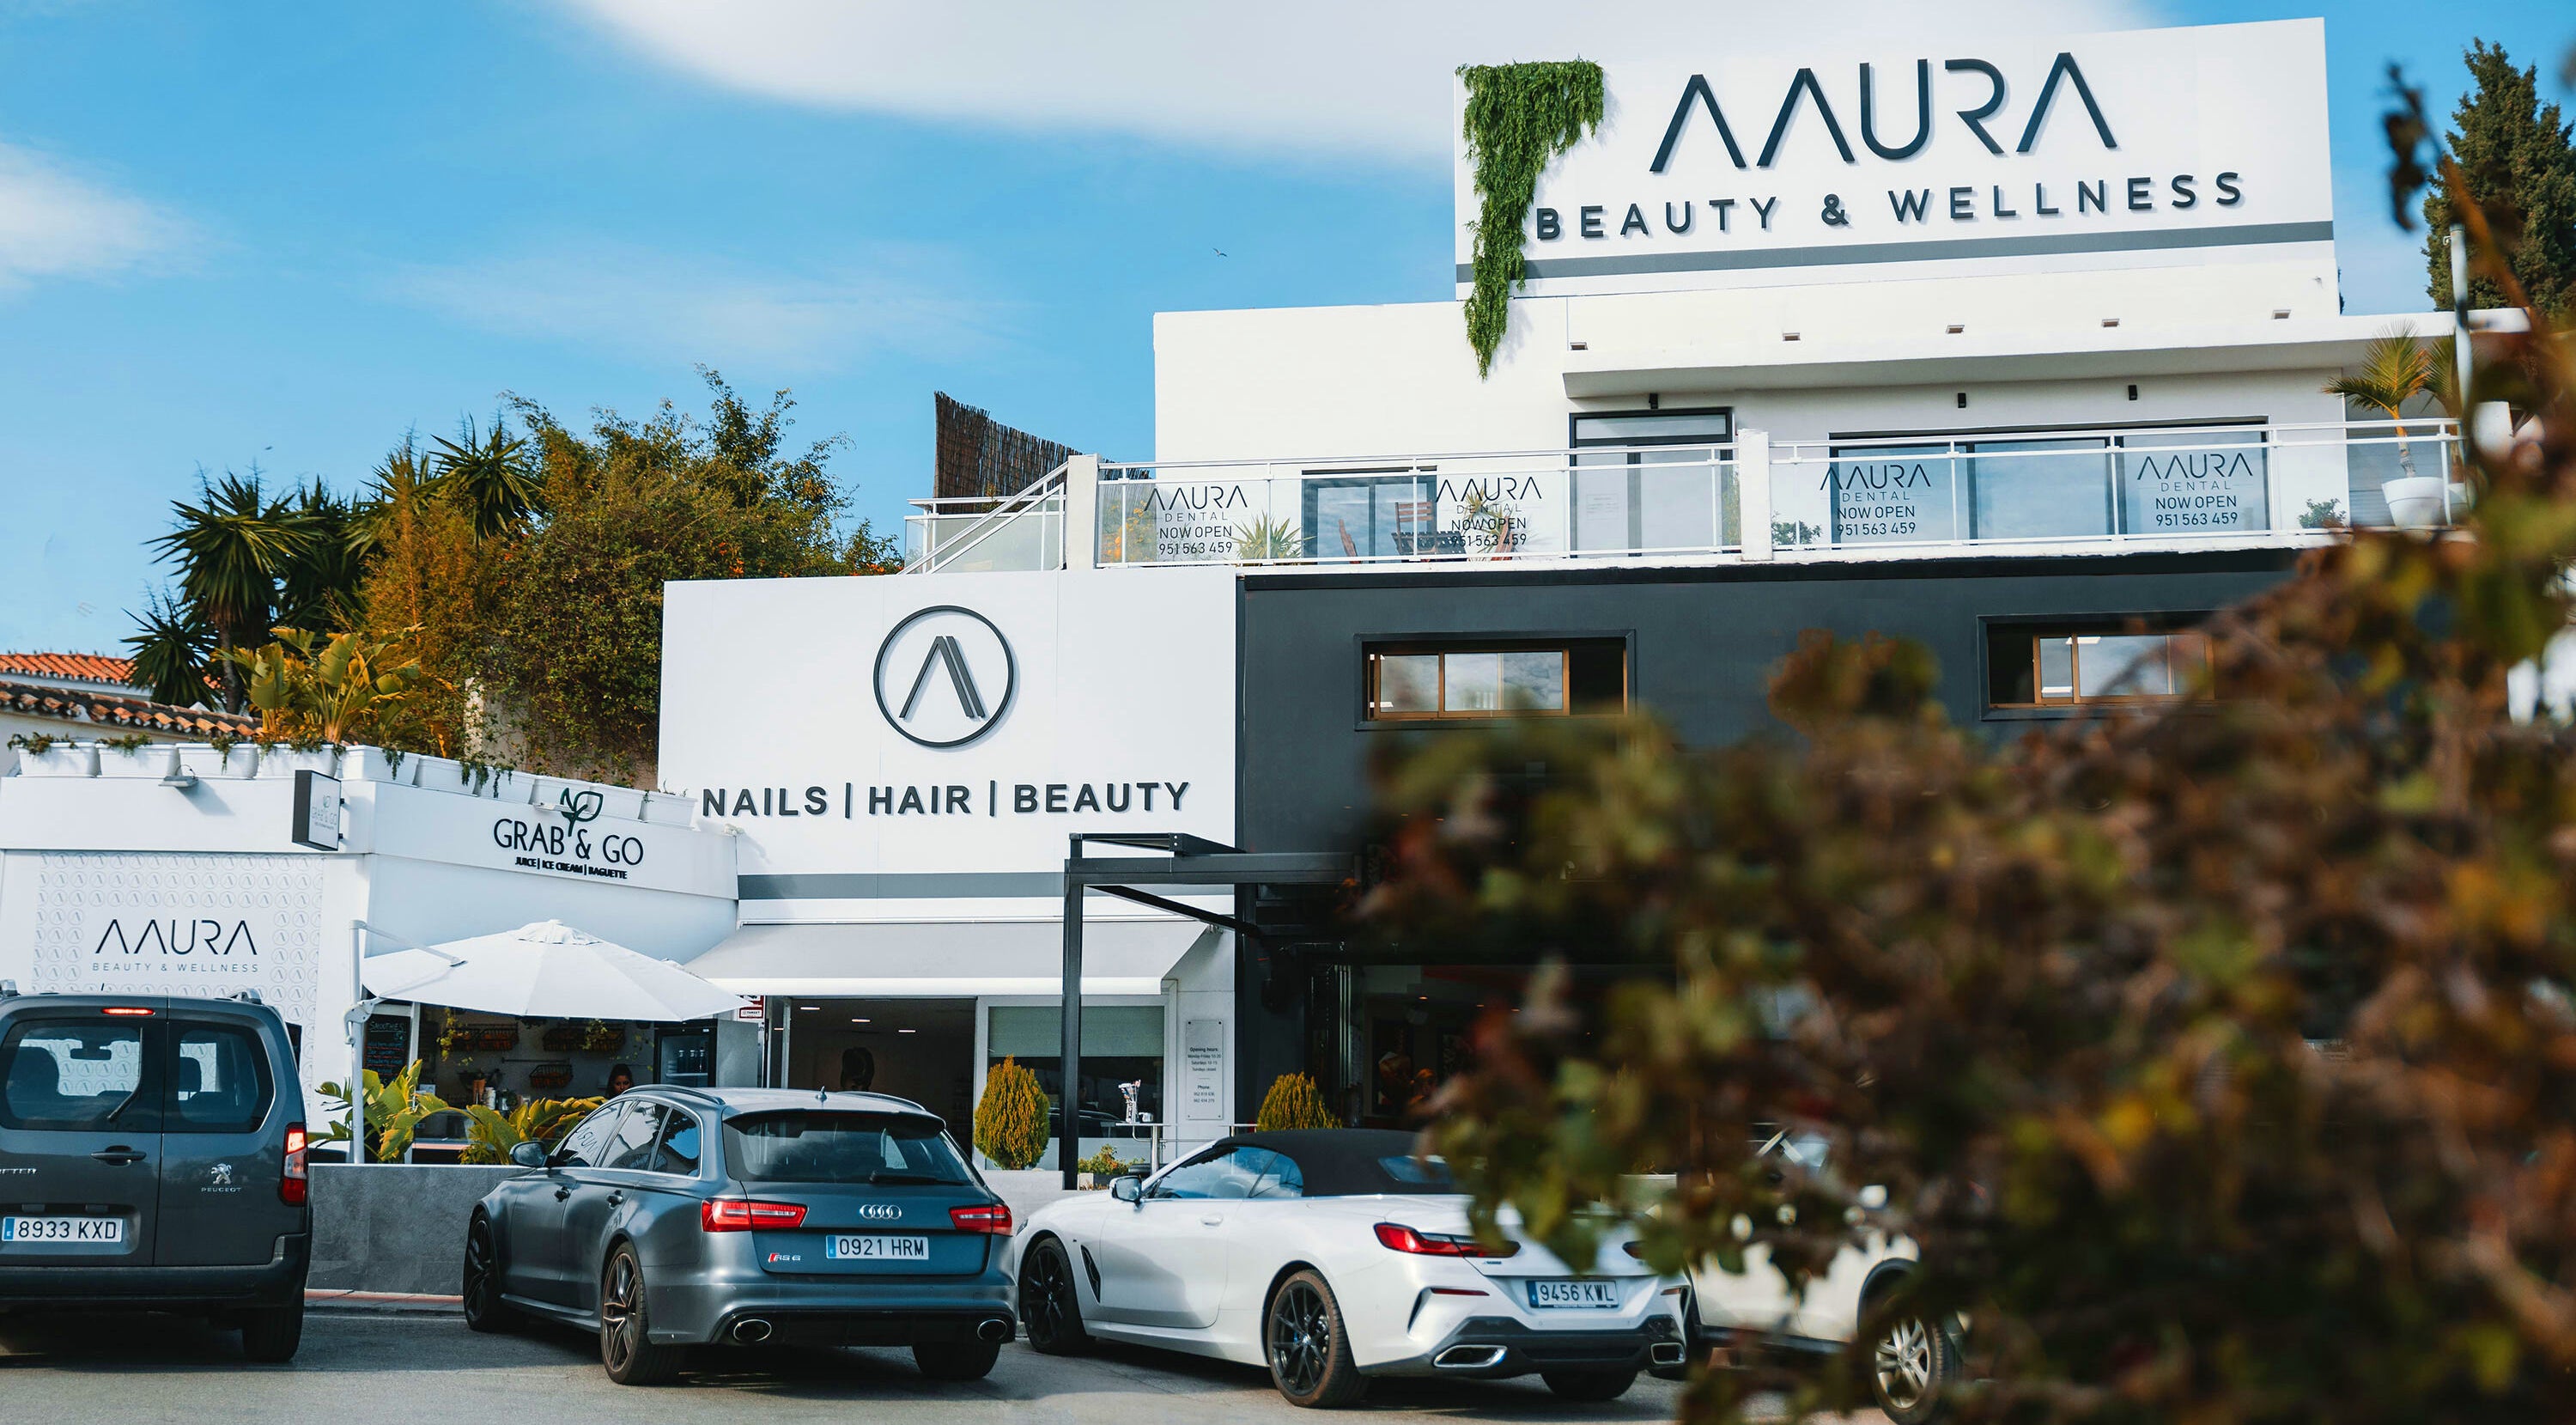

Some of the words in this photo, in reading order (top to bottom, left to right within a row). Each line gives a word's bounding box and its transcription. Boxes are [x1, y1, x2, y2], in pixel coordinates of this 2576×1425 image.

[1649, 52, 2117, 174] AAURA
[1535, 196, 1777, 241] BEAUTY
[1820, 193, 1850, 226] &
[1887, 172, 2242, 223] WELLNESS
[2136, 452, 2254, 480] AAURA
[1820, 463, 1931, 490] AAURA
[2160, 480, 2232, 492] DENTAL
[1144, 484, 1248, 512] AAURA
[1842, 490, 1911, 502] DENTAL
[2155, 496, 2191, 510] NOW
[2194, 495, 2237, 508] OPEN
[1164, 511, 1228, 522] DENTAL
[1456, 503, 1522, 515] DENTAL
[1837, 507, 1871, 520] NOW
[1874, 505, 1915, 519] OPEN
[1451, 519, 1485, 531] NOW
[1487, 517, 1527, 530] OPEN
[2155, 514, 2178, 527] 951
[2182, 513, 2208, 526] 563
[2211, 512, 2238, 524] 459
[1159, 527, 1192, 539] NOW
[1194, 525, 1232, 539] OPEN
[1837, 523, 1858, 536] 951
[1862, 522, 1887, 535] 563
[1891, 521, 1916, 534] 459
[1451, 535, 1472, 547] 951
[1475, 534, 1498, 546] 563
[1502, 533, 1527, 545] 459
[1158, 543, 1179, 555] 951
[1182, 542, 1206, 554] 563
[1209, 541, 1233, 553] 459
[702, 786, 828, 816] NAILS
[868, 785, 971, 814] HAIR
[1013, 782, 1189, 813] BEAUTY
[494, 818, 565, 856] GRAB
[575, 828, 592, 860] &
[602, 834, 644, 866] GO
[515, 856, 537, 868] JUICE
[542, 860, 555, 869] ICE
[556, 862, 583, 874] CREAM
[588, 867, 628, 880] BAGUETTE
[95, 919, 258, 955] AAURA
[92, 963, 152, 971] BEAUTY
[161, 963, 167, 971] &
[177, 963, 258, 972] WELLNESS
[18, 1221, 70, 1239] 8933
[78, 1221, 117, 1239] KXD
[839, 1239, 883, 1256] 0921
[891, 1239, 924, 1257] HRM
[1540, 1284, 1579, 1301] 9456
[1584, 1284, 1614, 1301] KWL
